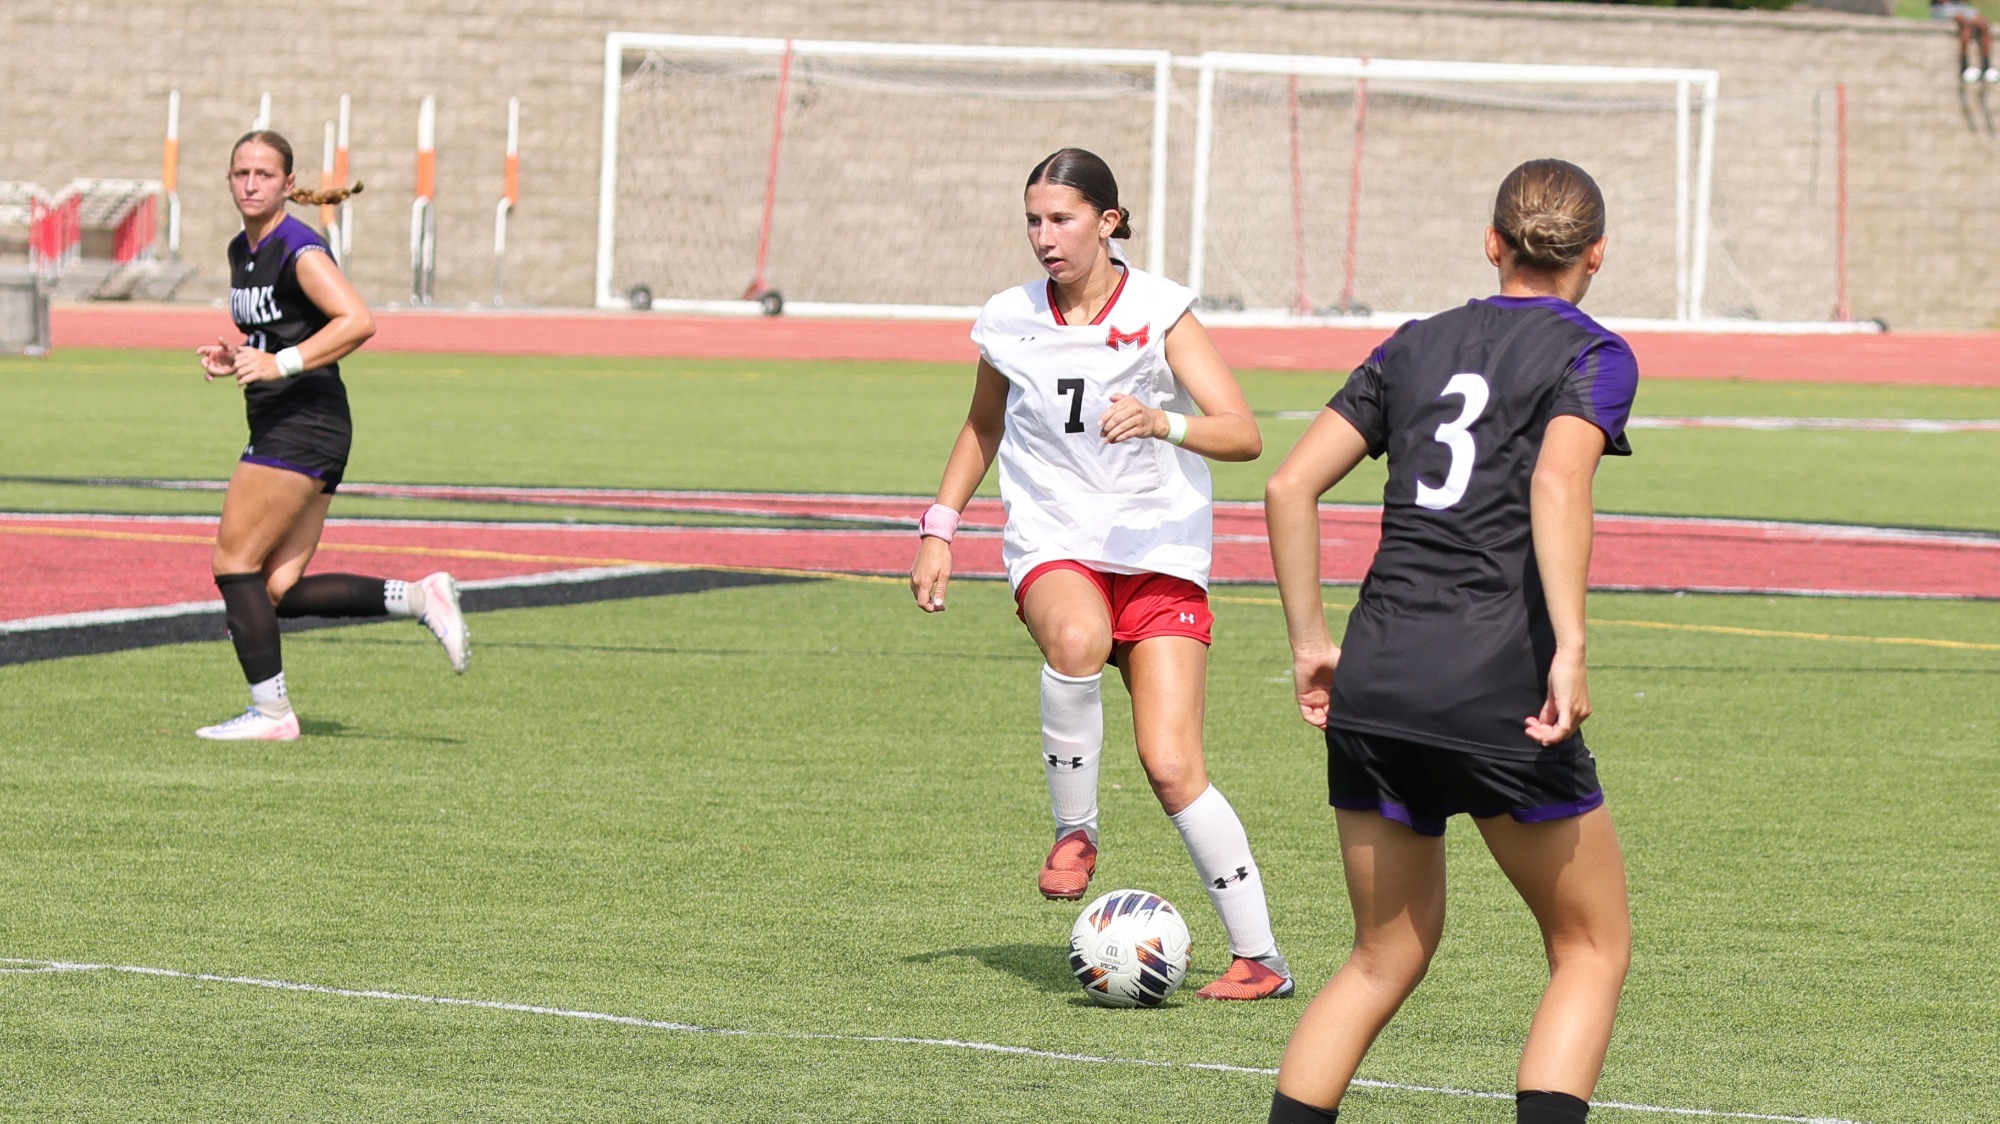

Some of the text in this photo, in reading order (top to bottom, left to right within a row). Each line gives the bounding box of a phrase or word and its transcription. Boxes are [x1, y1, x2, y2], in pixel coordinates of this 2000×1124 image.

[1057, 378, 1085, 433] 7
[1416, 373, 1489, 510] 3
[1100, 961, 1119, 971] NCAA
